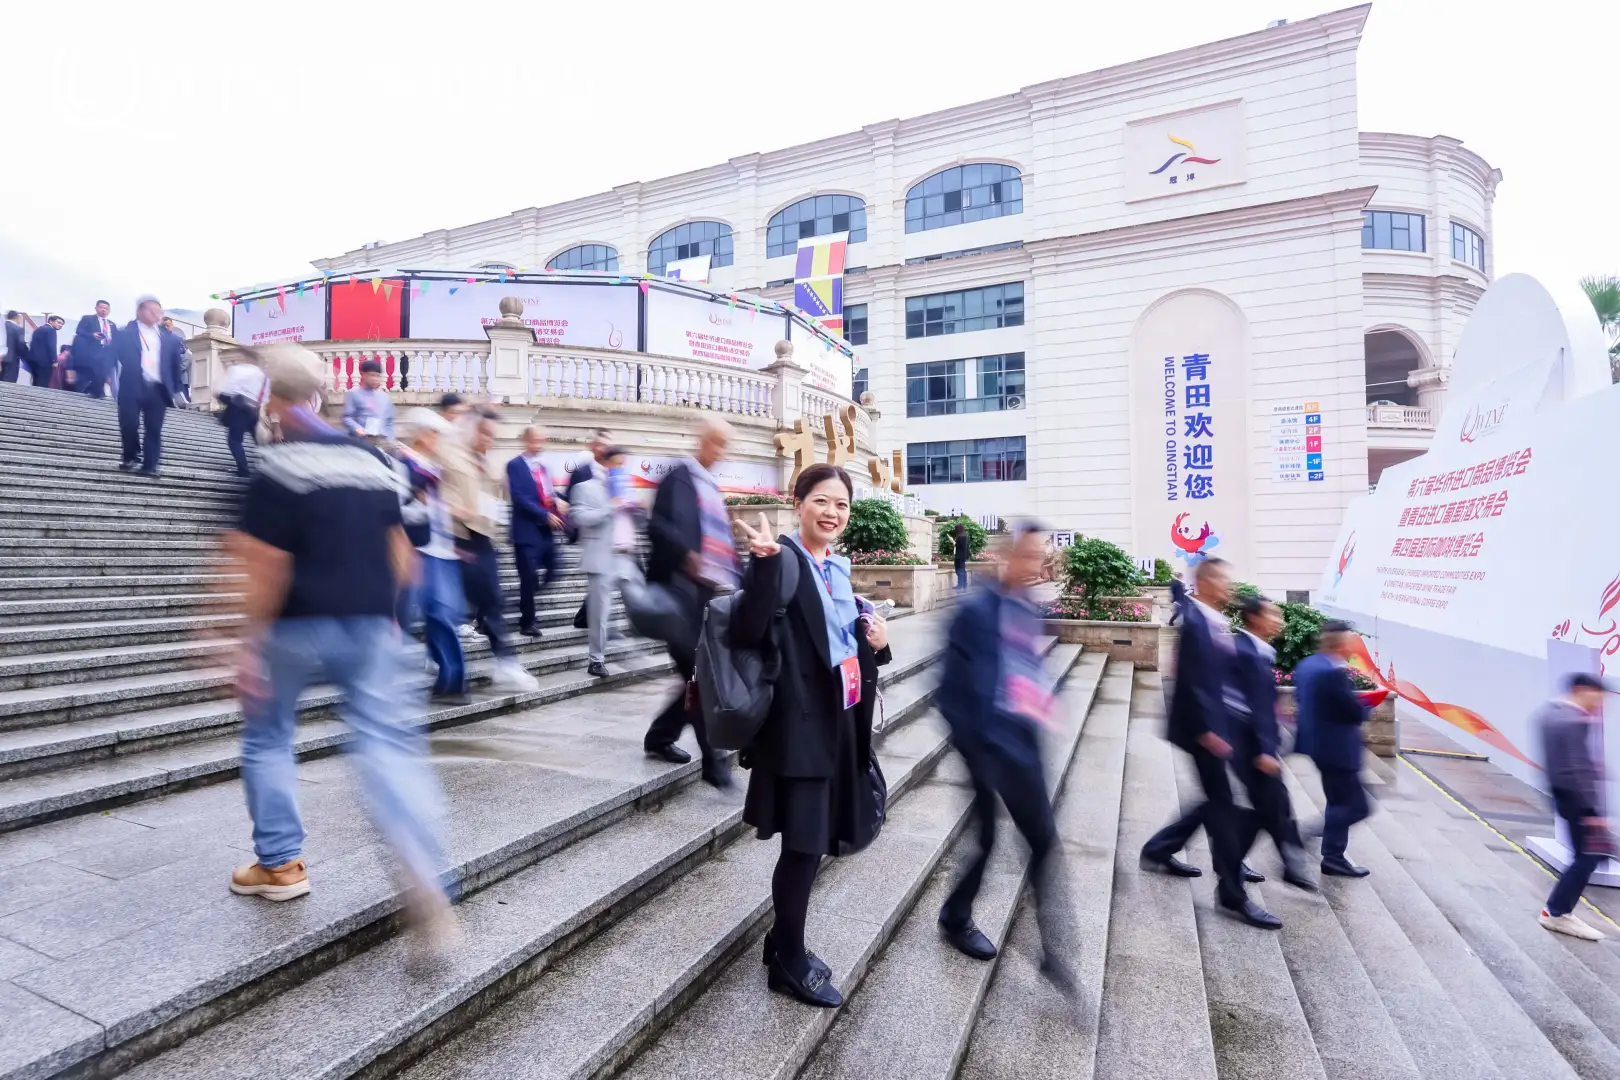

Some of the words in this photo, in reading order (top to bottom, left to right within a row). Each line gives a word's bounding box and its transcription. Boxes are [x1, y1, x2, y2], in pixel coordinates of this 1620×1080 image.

[1164, 356, 1176, 417] WELCOME
[1165, 419, 1176, 437] TO
[1181, 353, 1215, 500] 青田欢迎您
[1166, 440, 1178, 501] QINGTIAN
[1405, 446, 1531, 499] 第六届华侨进口商品博览会
[1398, 489, 1509, 528] 暨青田进口葡萄酒交易会
[1390, 531, 1484, 558] 第四届国际咖啡博览会
[1469, 571, 1486, 580] EXPO
[1435, 600, 1448, 609] EXPO
